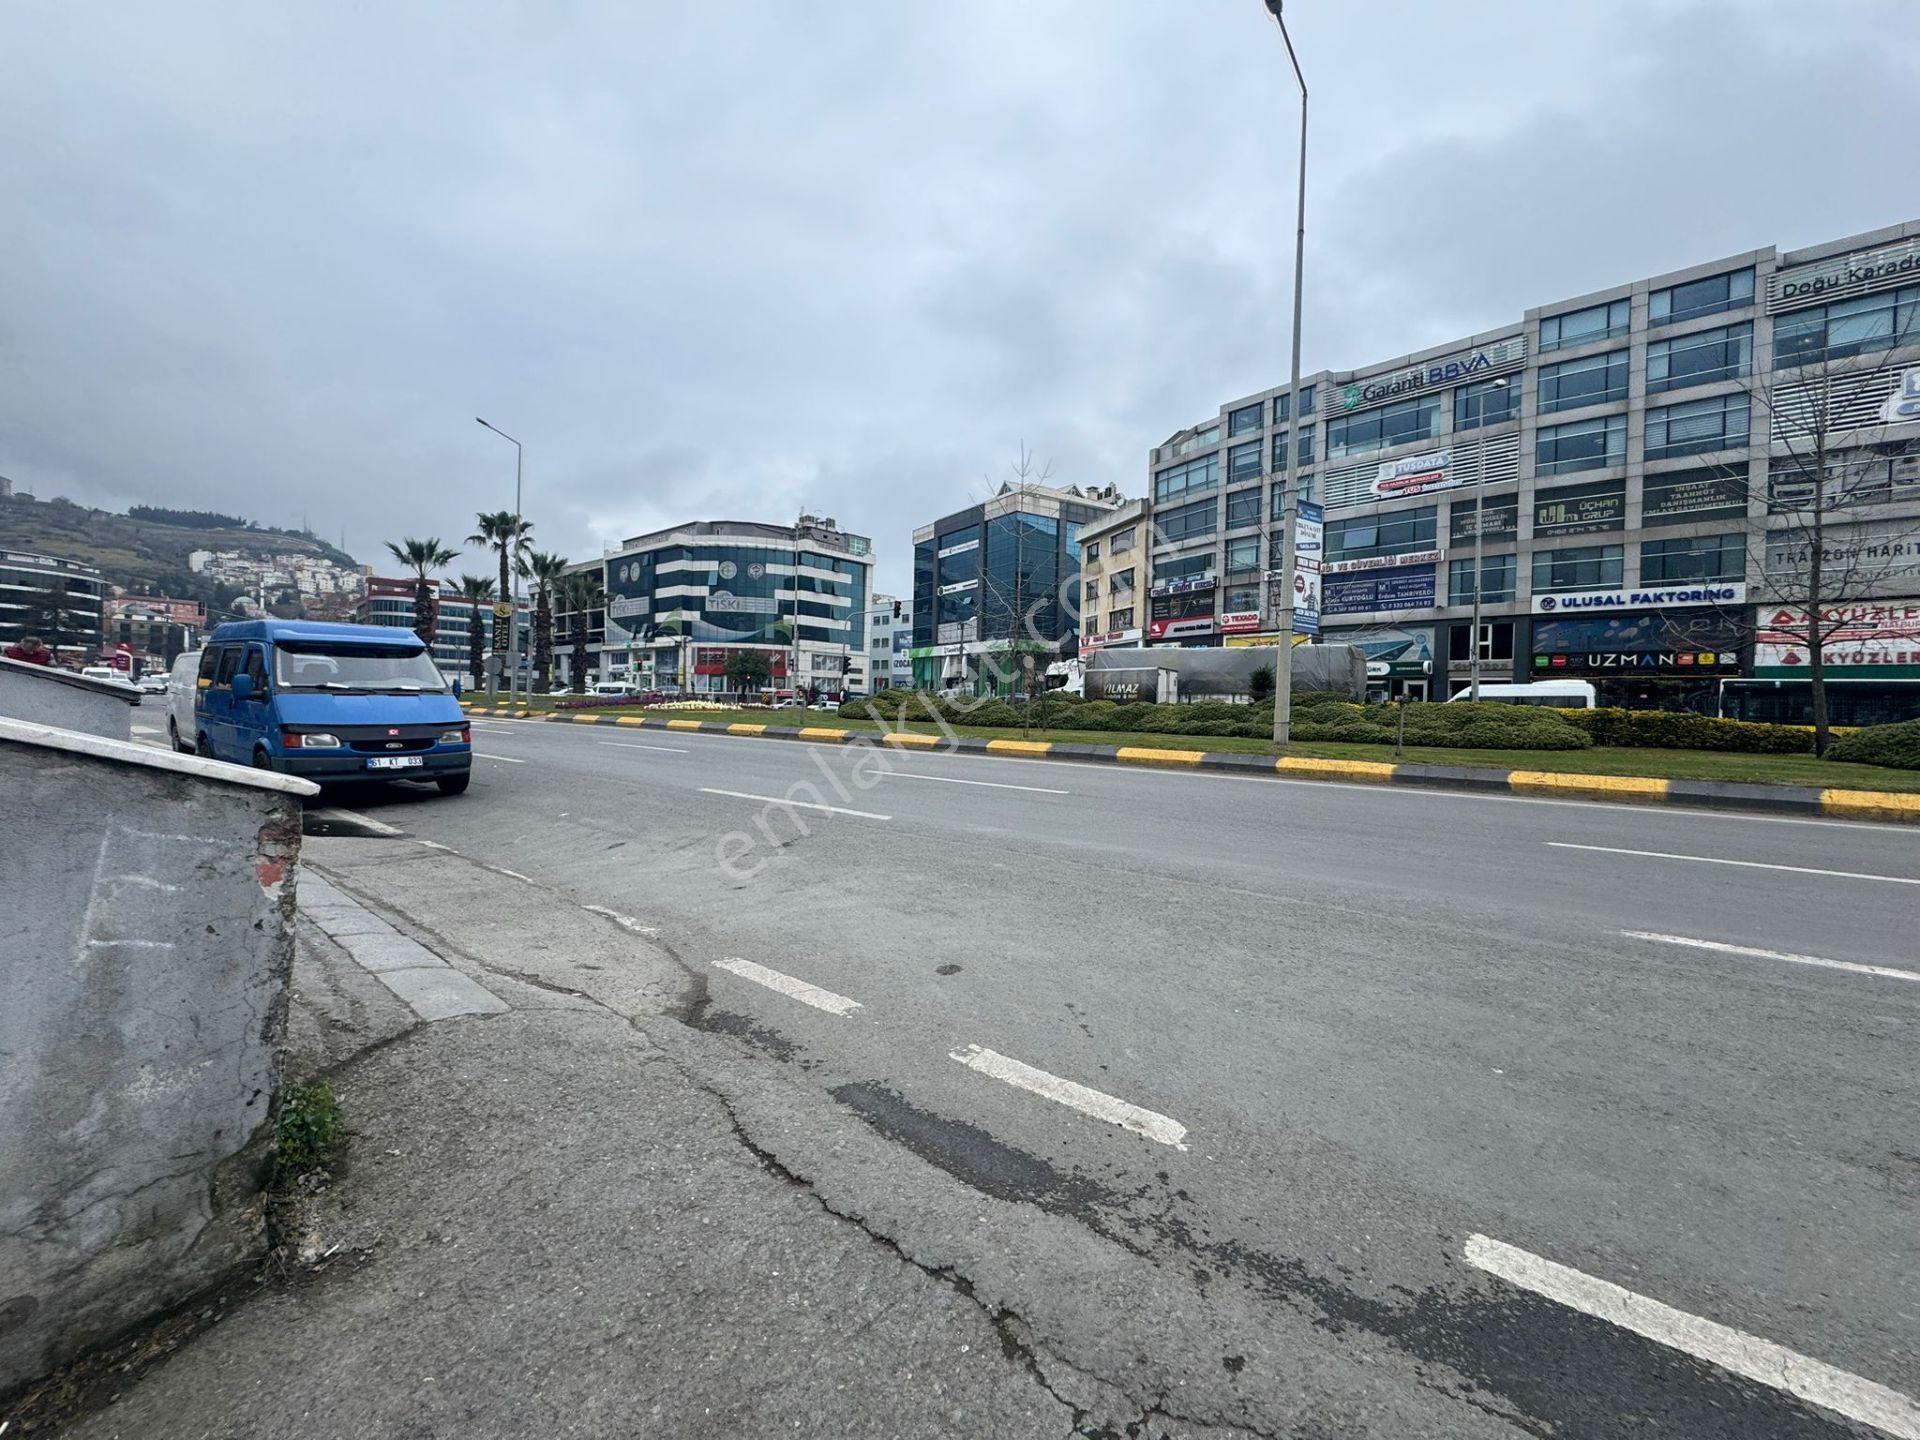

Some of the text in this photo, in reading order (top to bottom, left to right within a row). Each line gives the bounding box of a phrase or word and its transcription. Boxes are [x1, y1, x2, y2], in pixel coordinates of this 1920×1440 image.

[1783, 275, 1839, 297] Doğu
[1363, 352, 1491, 400] Garanti BBVA
[1397, 457, 1444, 473] TUSDATA
[1582, 509, 1614, 520] GRUP
[1776, 549, 1855, 565] TRAZON
[1562, 595, 1625, 608] ULUSAL
[1631, 588, 1735, 604] FAKTORING
[1231, 613, 1258, 622] TEXACO
[1588, 653, 1674, 667] UZMAN
[1812, 651, 1920, 664] KYÜZLER
[1103, 683, 1139, 694] YILMAZ
[389, 758, 398, 766] KT
[408, 757, 422, 765] 033
